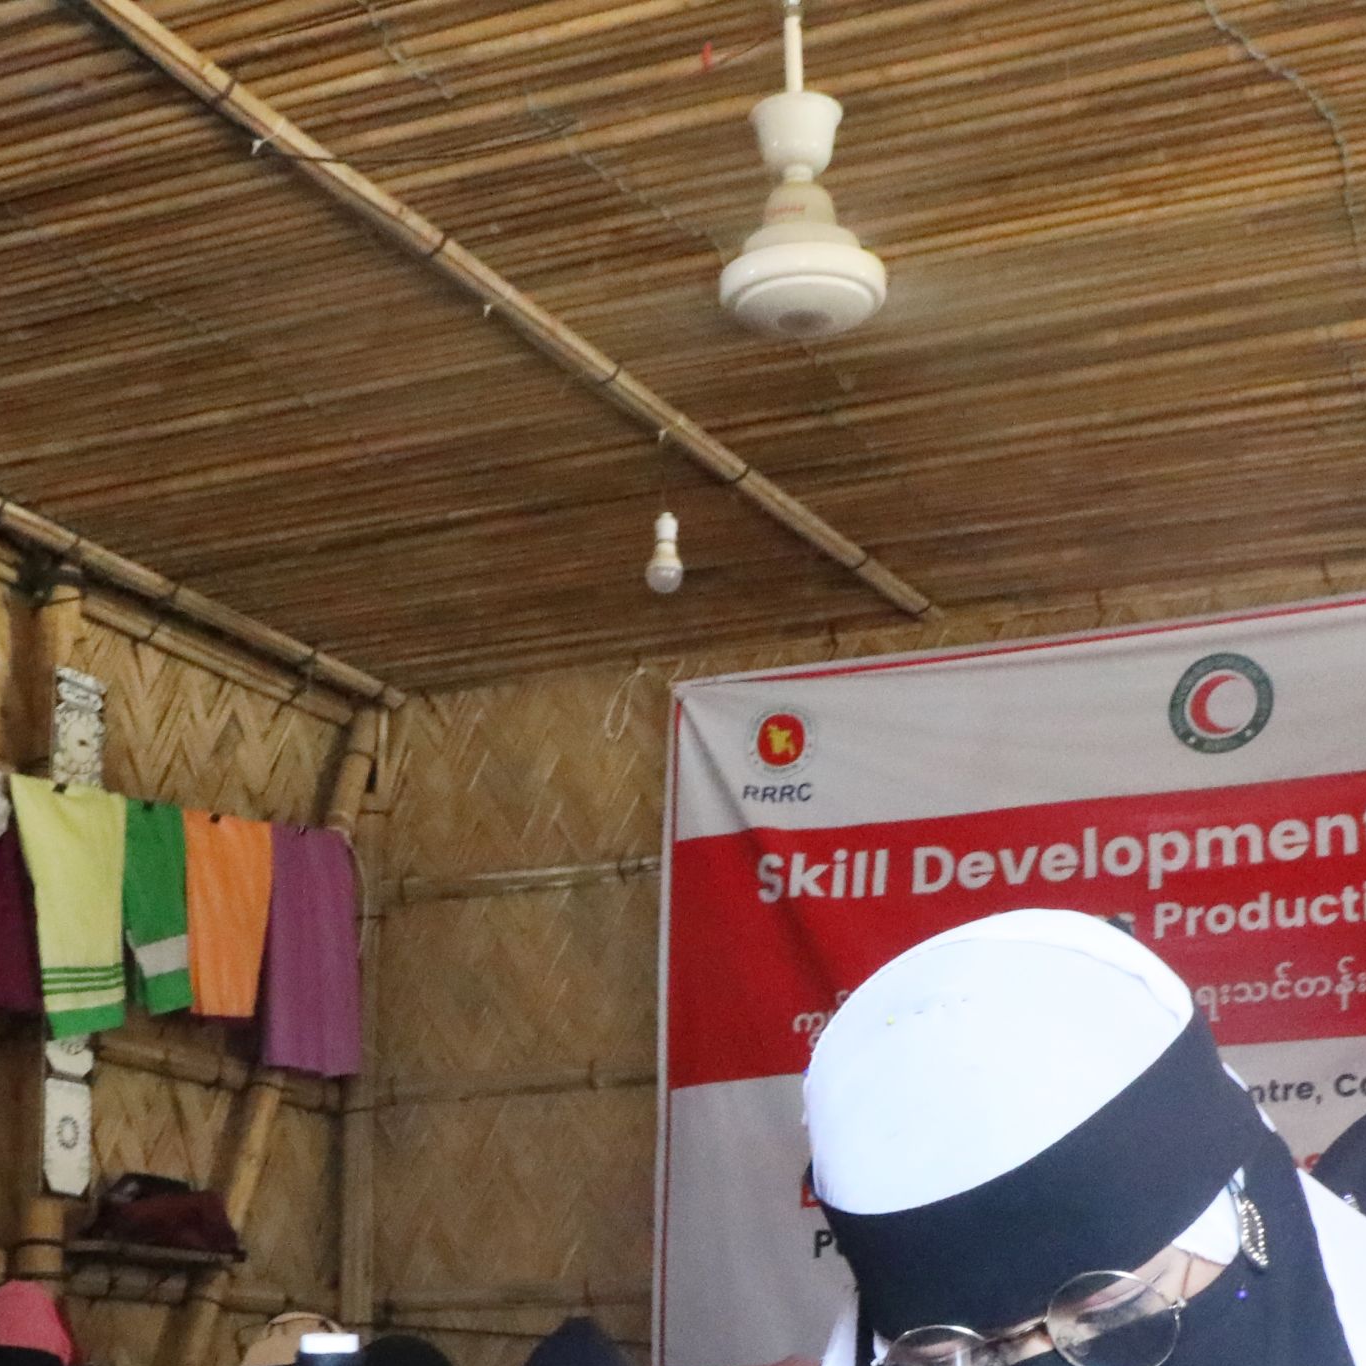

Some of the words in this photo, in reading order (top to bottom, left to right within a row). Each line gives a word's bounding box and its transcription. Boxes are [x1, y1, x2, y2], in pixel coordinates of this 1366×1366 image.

[742, 782, 812, 803] RRRC
[756, 848, 889, 904] Skill
[1247, 1079, 1323, 1106] ntre,
